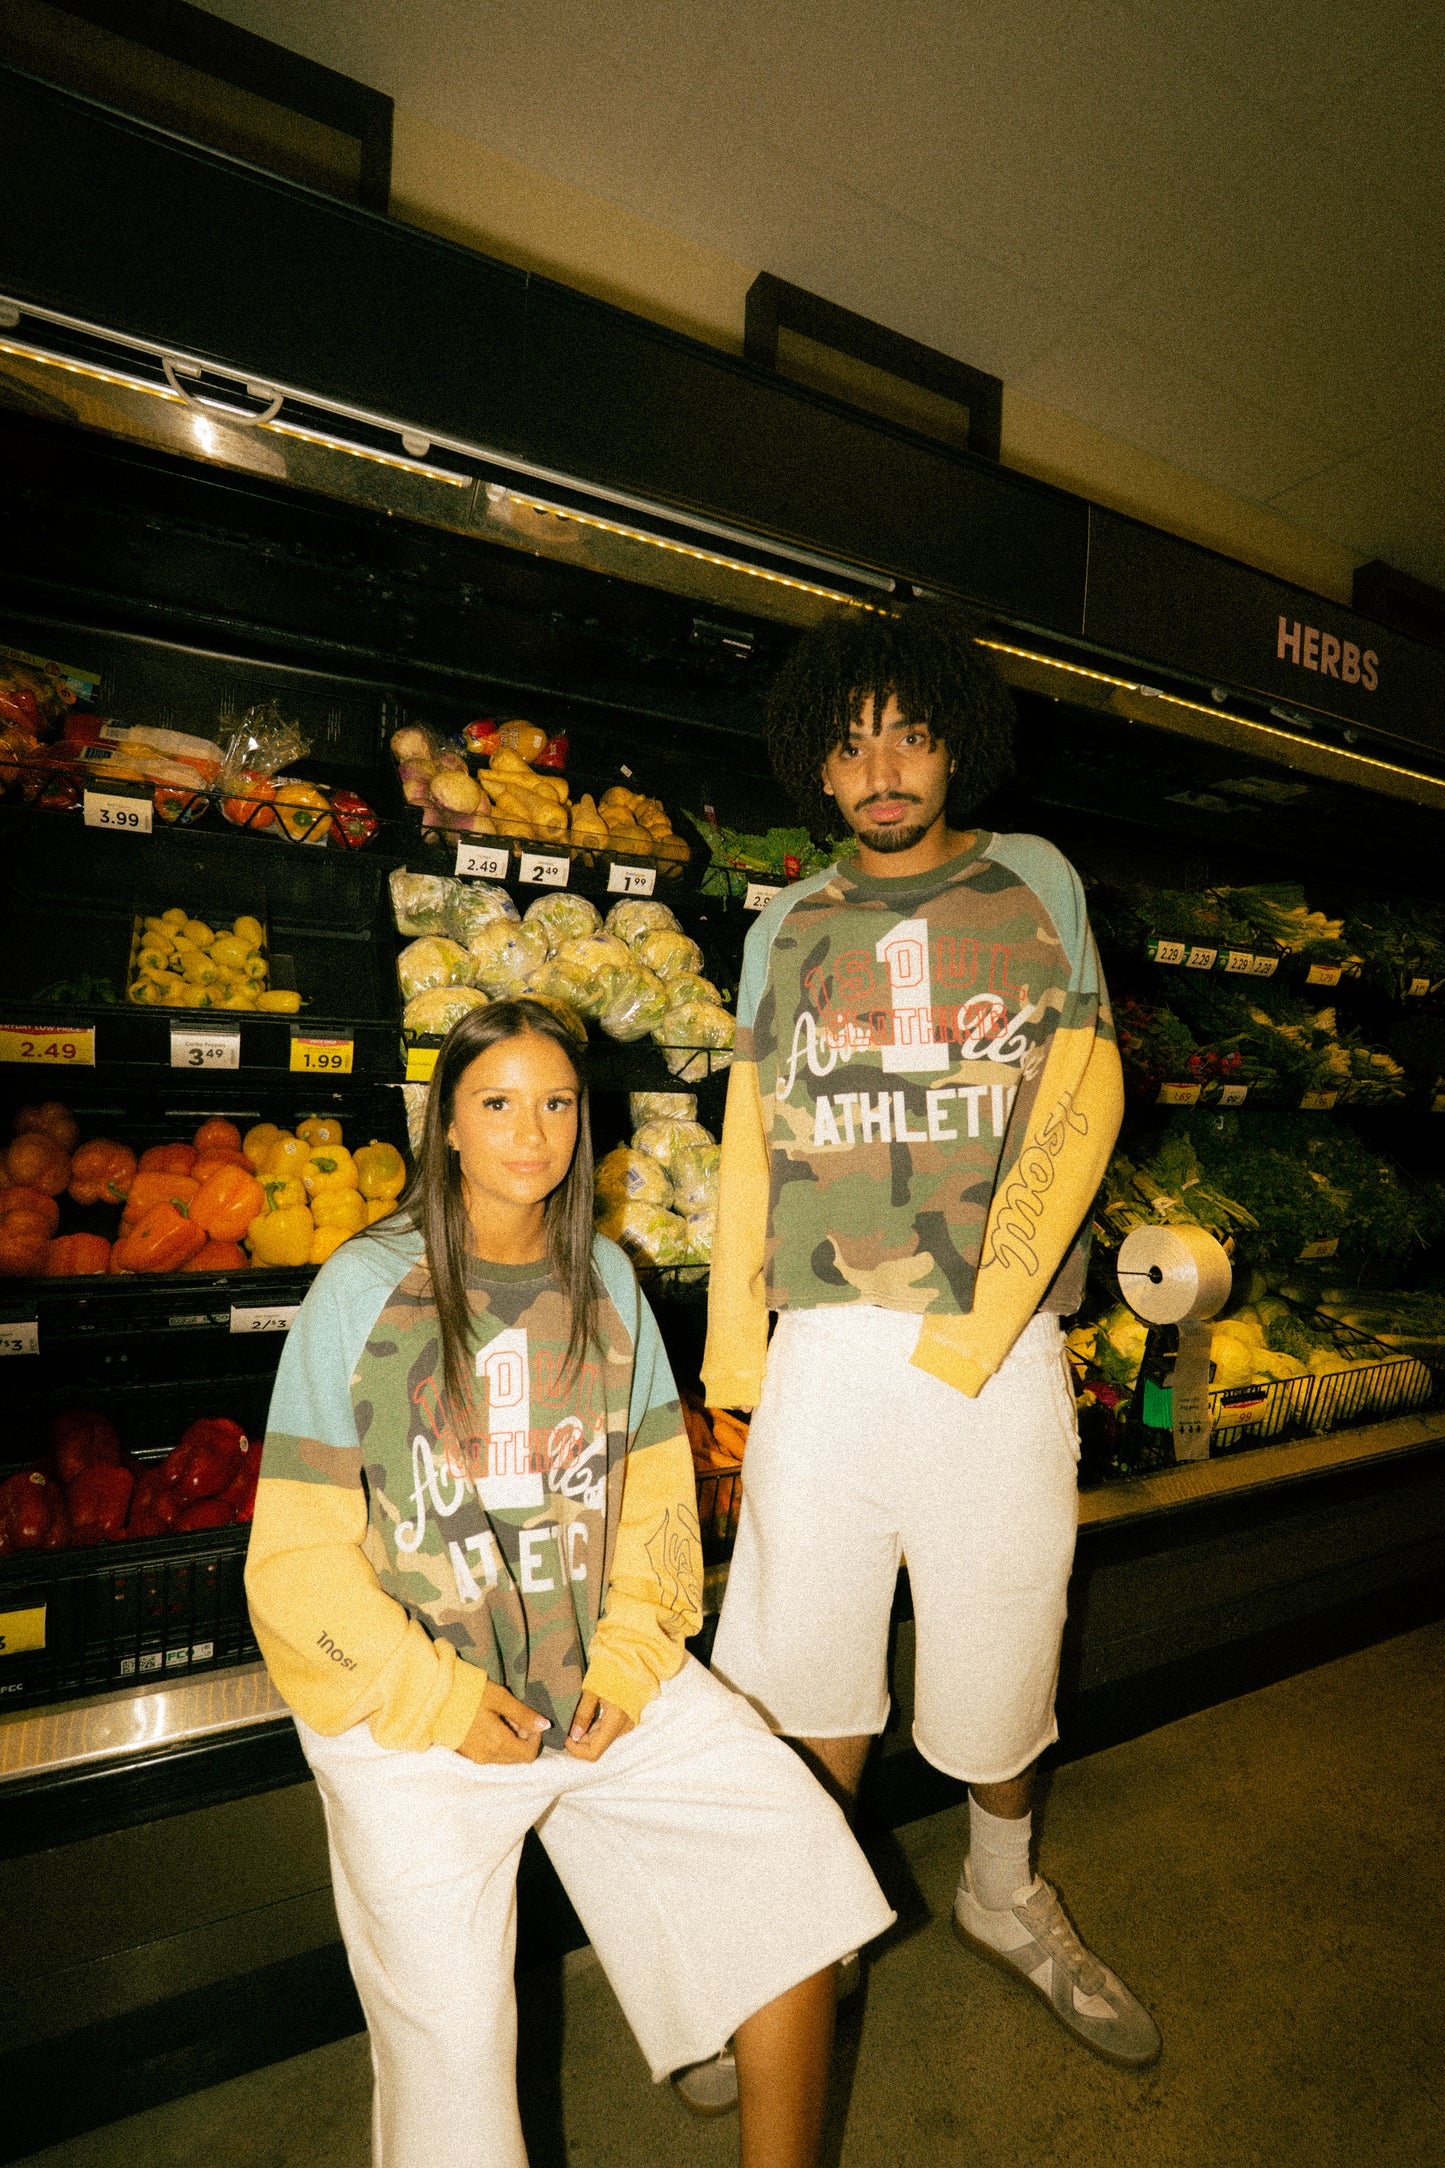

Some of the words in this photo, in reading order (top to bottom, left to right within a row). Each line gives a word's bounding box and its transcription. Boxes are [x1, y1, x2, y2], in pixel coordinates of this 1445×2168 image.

[1277, 615, 1379, 691] HERBS
[100, 809, 139, 827] 3.99
[467, 859, 498, 873] 2.49
[1161, 948, 1179, 960] 2.29
[1192, 953, 1210, 966] 2.29
[1231, 958, 1248, 970] 2.29
[825, 1002, 1009, 1049] CLOTHING
[21, 1041, 77, 1059] 2.49
[303, 1053, 343, 1069] 1.99
